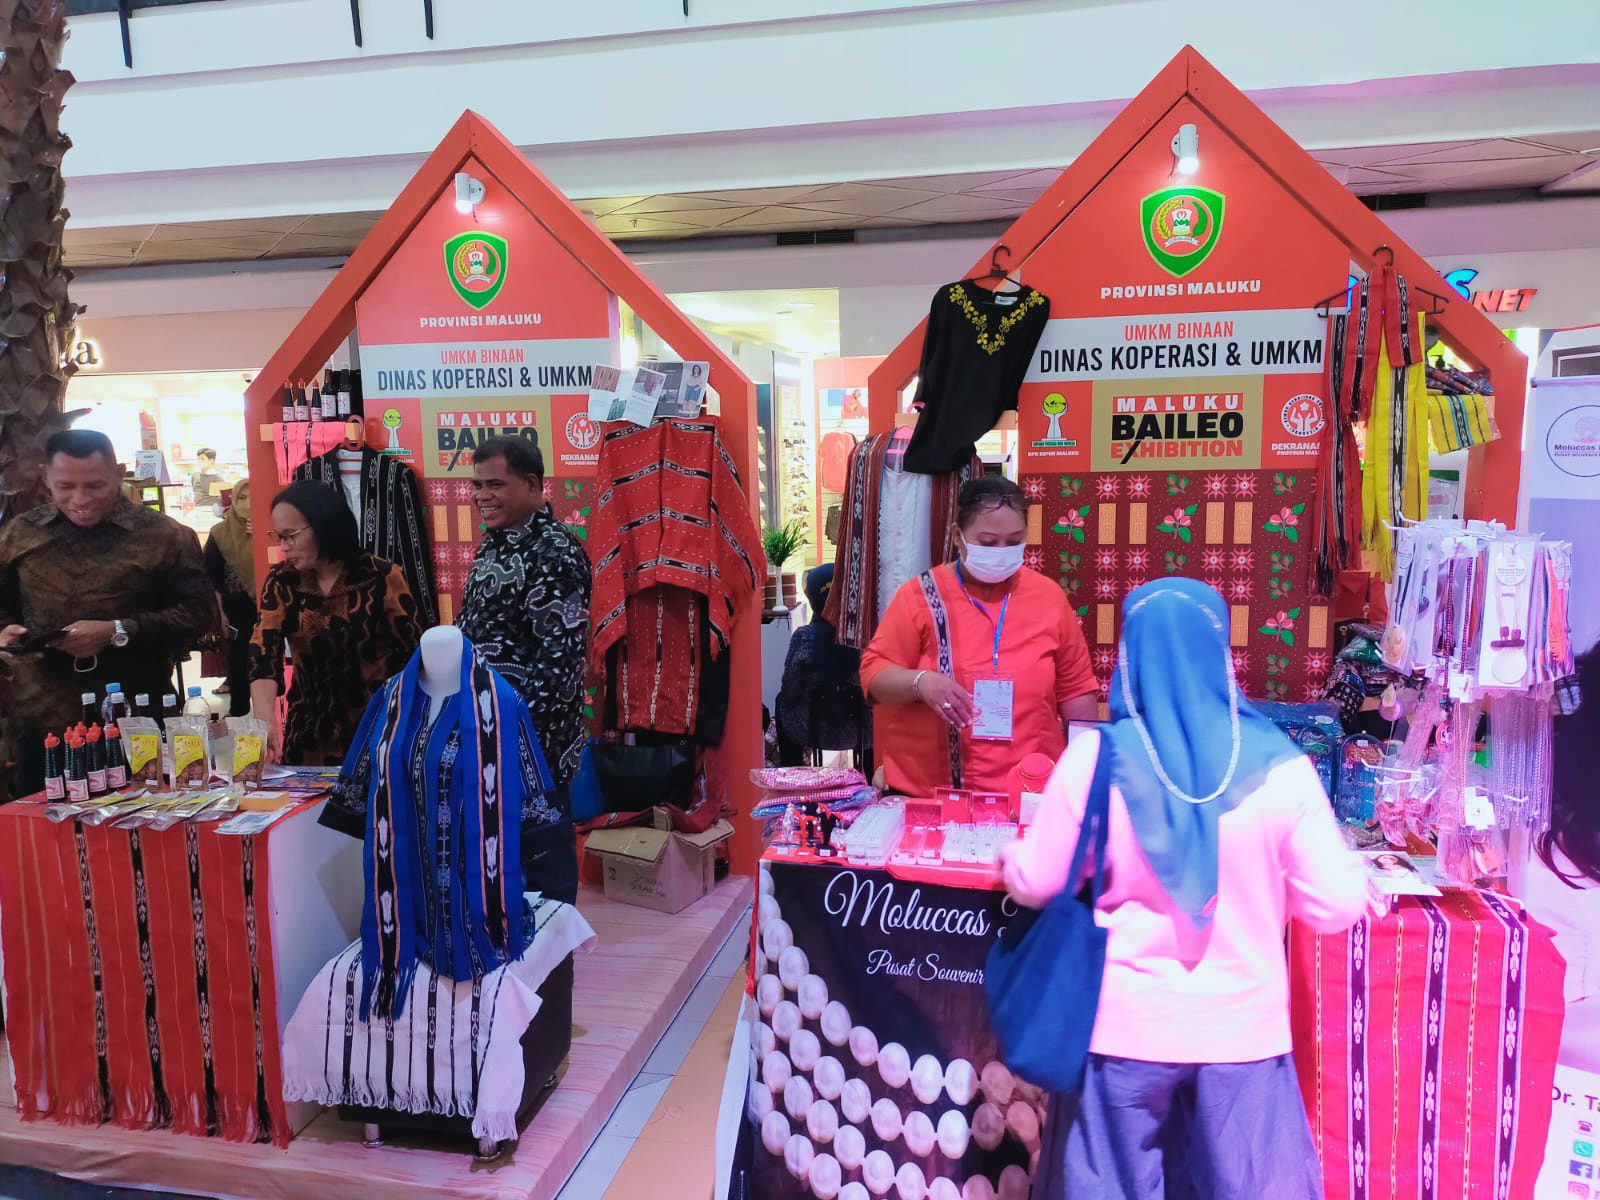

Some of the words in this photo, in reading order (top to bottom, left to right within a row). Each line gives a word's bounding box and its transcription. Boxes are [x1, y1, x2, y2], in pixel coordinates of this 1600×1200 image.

[1101, 283, 1183, 299] PROVINSI
[1188, 280, 1261, 296] MALUKU
[1472, 288, 1538, 312] NET
[420, 316, 483, 328] PROVINSI
[486, 313, 542, 326] MALUKU
[1125, 323, 1171, 341] UMKM
[1177, 321, 1234, 338] BINAAN
[440, 350, 477, 365] UMKM
[481, 348, 524, 364] BINAAN
[1040, 348, 1102, 374] DINAS
[1111, 343, 1217, 370] KOPERASI
[1226, 342, 1241, 366] &
[1251, 340, 1322, 365] UMKM
[378, 369, 427, 392] DINAS
[432, 367, 513, 390] KOPERASI
[520, 367, 532, 388] &
[538, 365, 592, 388] UMKM
[1117, 395, 1239, 412] MALUKU
[440, 412, 533, 426] MALUKU
[1111, 411, 1244, 441] BAILEO
[1110, 440, 1243, 461] EXHIBITION
[1554, 443, 1597, 451] Moluccas
[824, 871, 990, 936] Moluccas
[866, 950, 914, 977] Pusat
[917, 953, 985, 985] Souvenir
